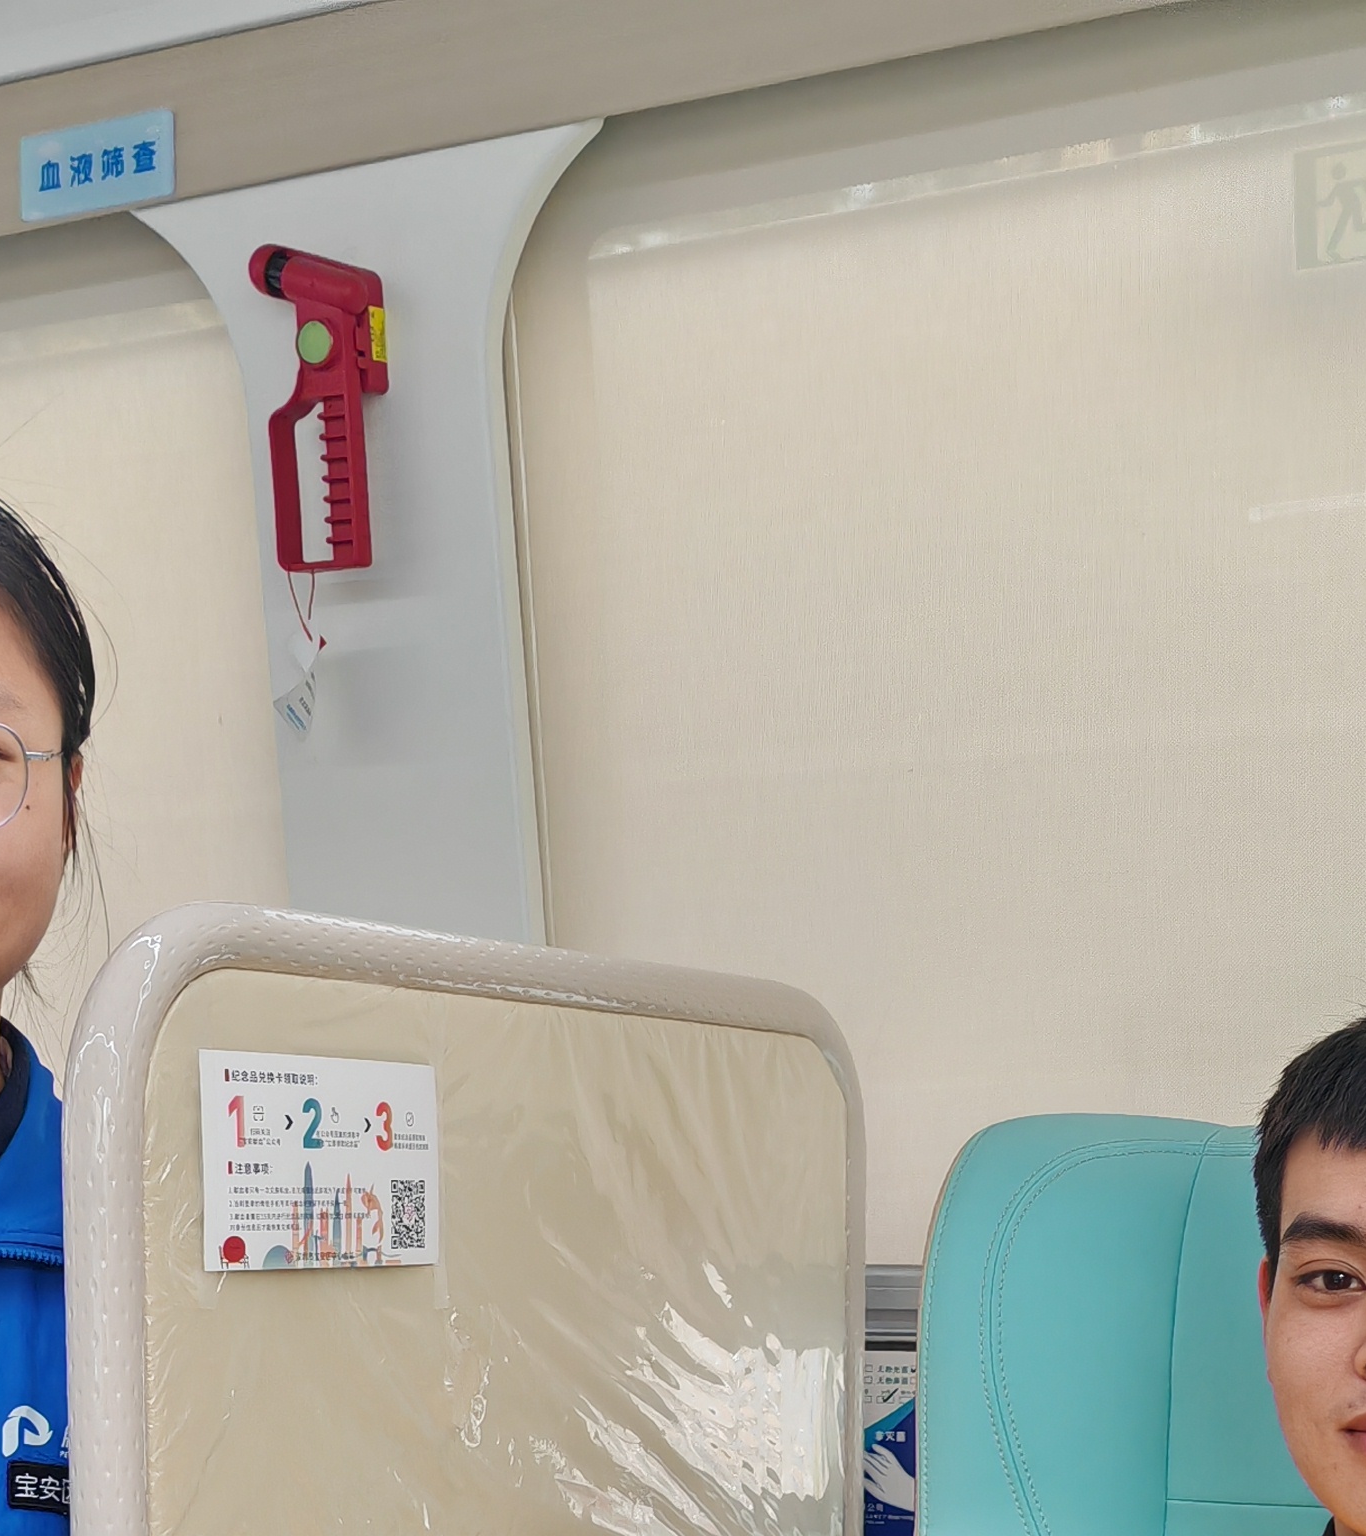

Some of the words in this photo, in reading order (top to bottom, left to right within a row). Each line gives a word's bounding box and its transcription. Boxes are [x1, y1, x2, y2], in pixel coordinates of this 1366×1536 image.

[38, 140, 157, 192] 血液筛查
[228, 1095, 246, 1148] 1
[302, 1098, 323, 1149] 2
[376, 1101, 394, 1151] 3
